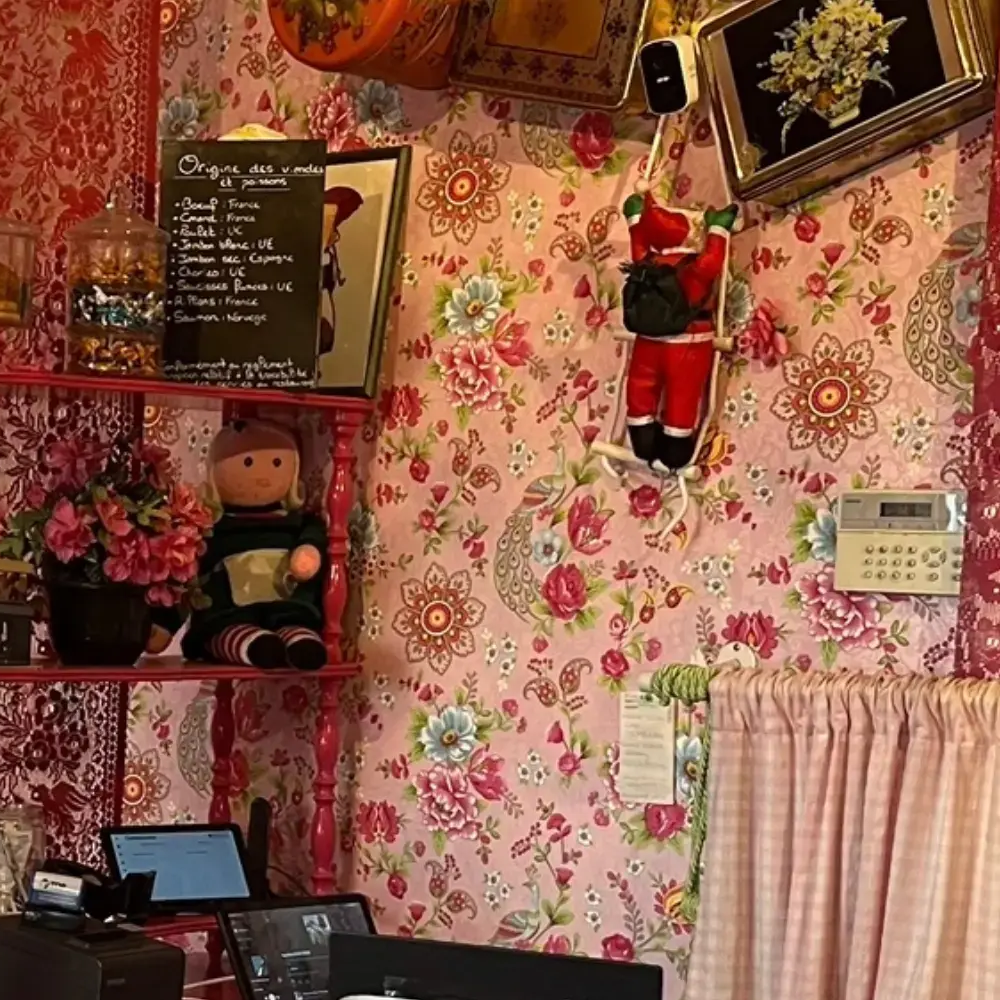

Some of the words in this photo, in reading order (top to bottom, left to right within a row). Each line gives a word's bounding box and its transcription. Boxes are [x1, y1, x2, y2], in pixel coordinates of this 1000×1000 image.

[178, 154, 240, 180] Origine
[249, 163, 274, 173] des
[220, 176, 232, 187] et
[228, 198, 260, 209] France
[227, 225, 243, 236] UE
[258, 237, 274, 250] UE
[229, 266, 246, 277] UE
[277, 281, 294, 292] UE
[225, 295, 259, 306] France
